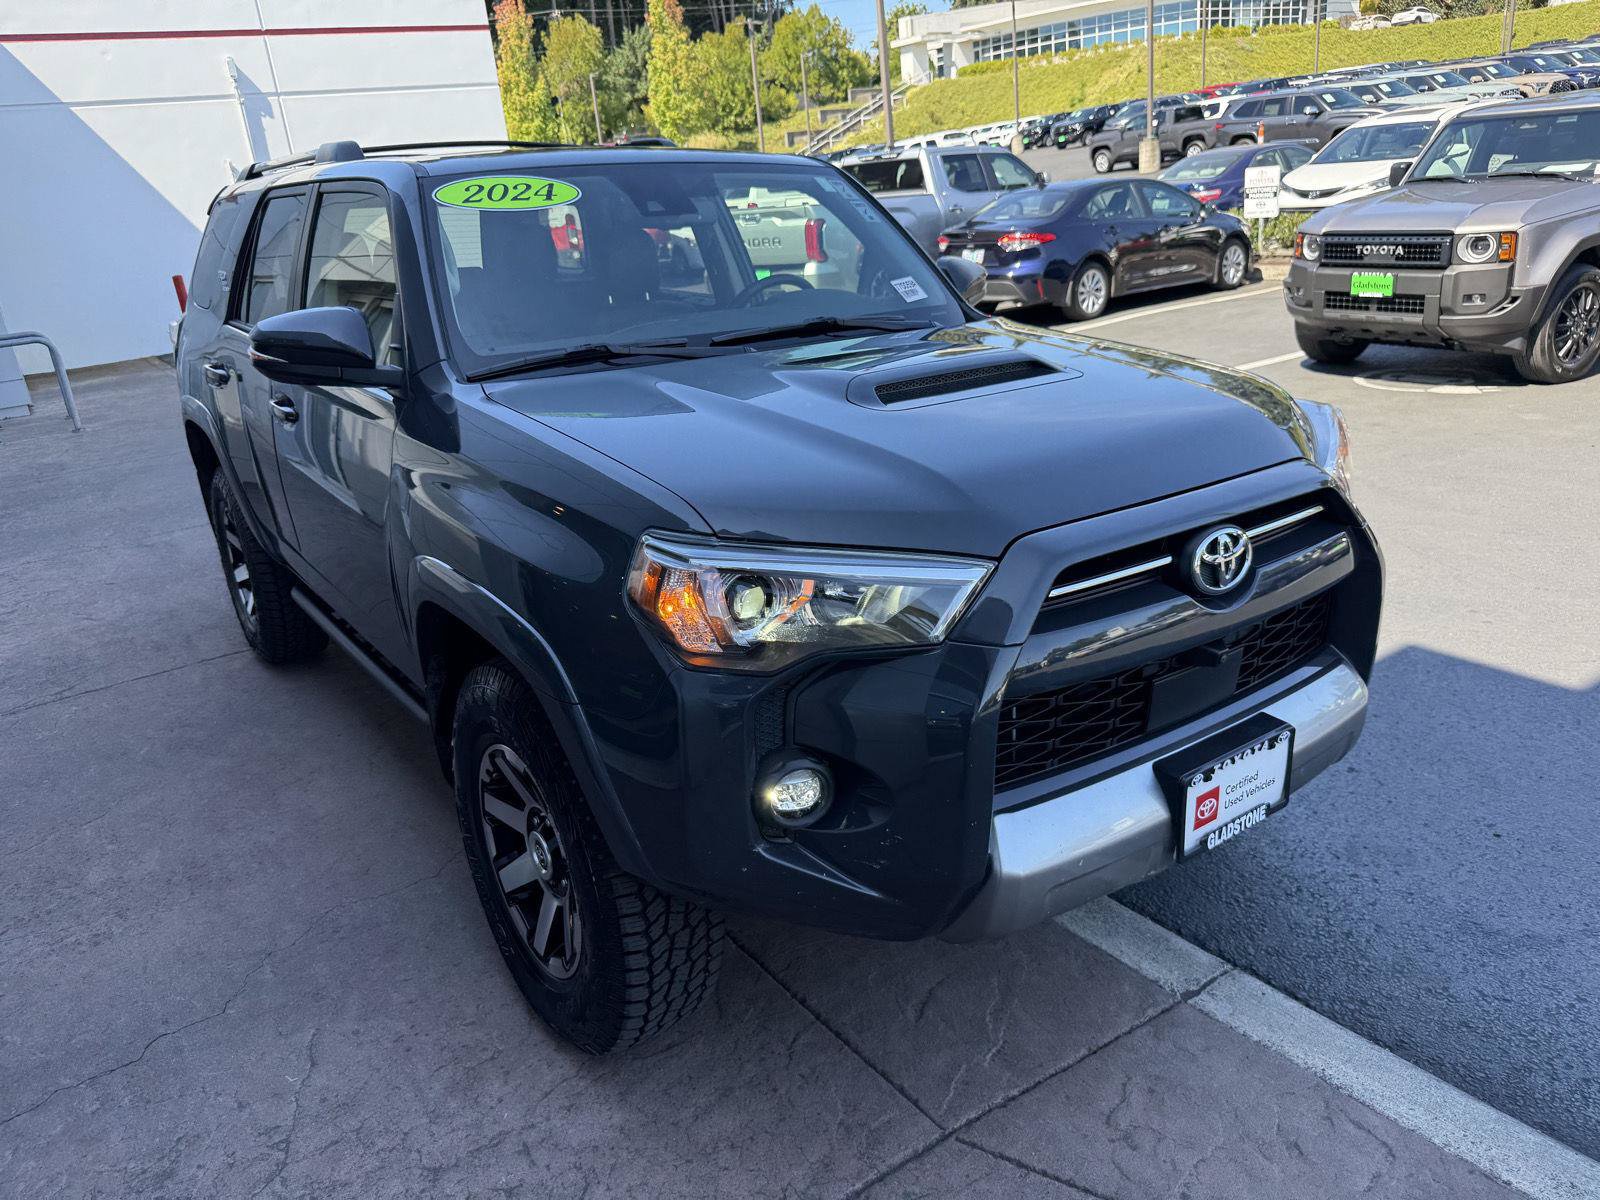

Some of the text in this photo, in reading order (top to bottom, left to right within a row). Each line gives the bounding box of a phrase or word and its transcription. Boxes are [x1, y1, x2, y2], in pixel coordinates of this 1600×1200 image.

[462, 183, 558, 204] 2024
[1355, 245, 1404, 256] TOYOTA
[1352, 281, 1391, 290] Gladstone
[1224, 778, 1276, 809] Used Vehicles
[1225, 771, 1259, 795] Certified
[1207, 804, 1268, 850] GLADSTONE
